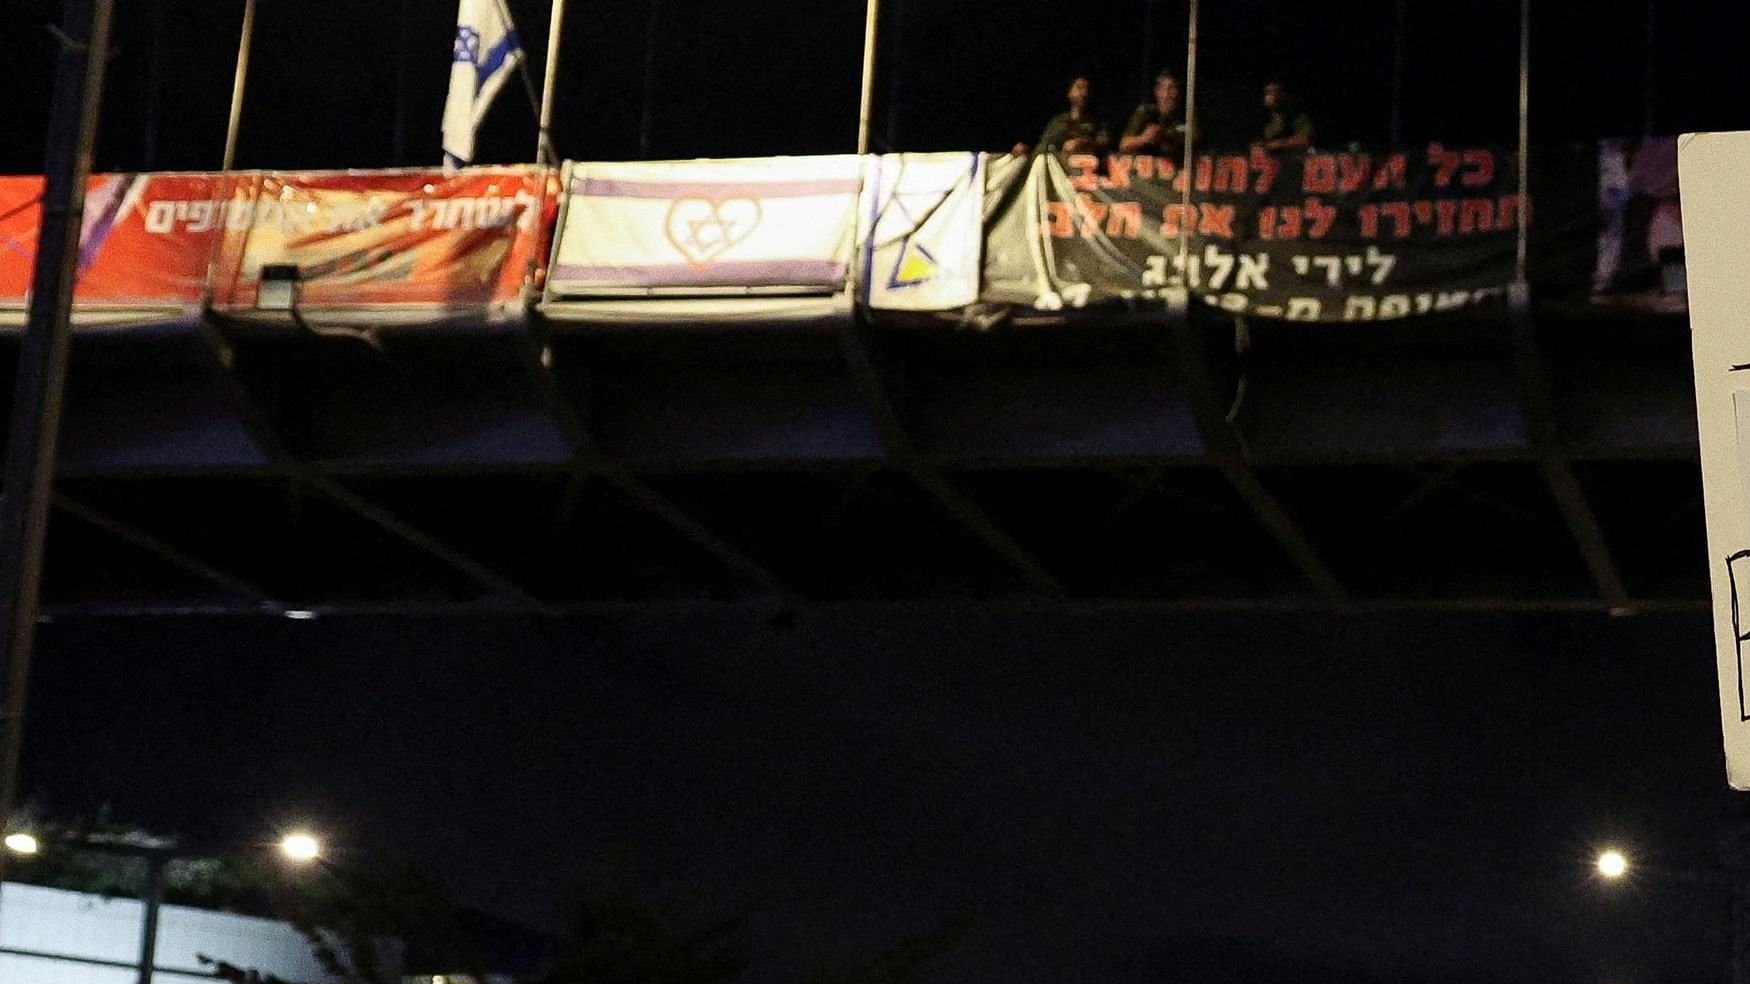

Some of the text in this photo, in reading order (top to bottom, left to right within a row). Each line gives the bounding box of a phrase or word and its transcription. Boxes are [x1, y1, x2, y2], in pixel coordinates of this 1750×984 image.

[1427, 141, 1496, 188] כל
[1159, 202, 1237, 240] את
[1258, 197, 1337, 241] לנו
[1290, 245, 1398, 289] לירי
